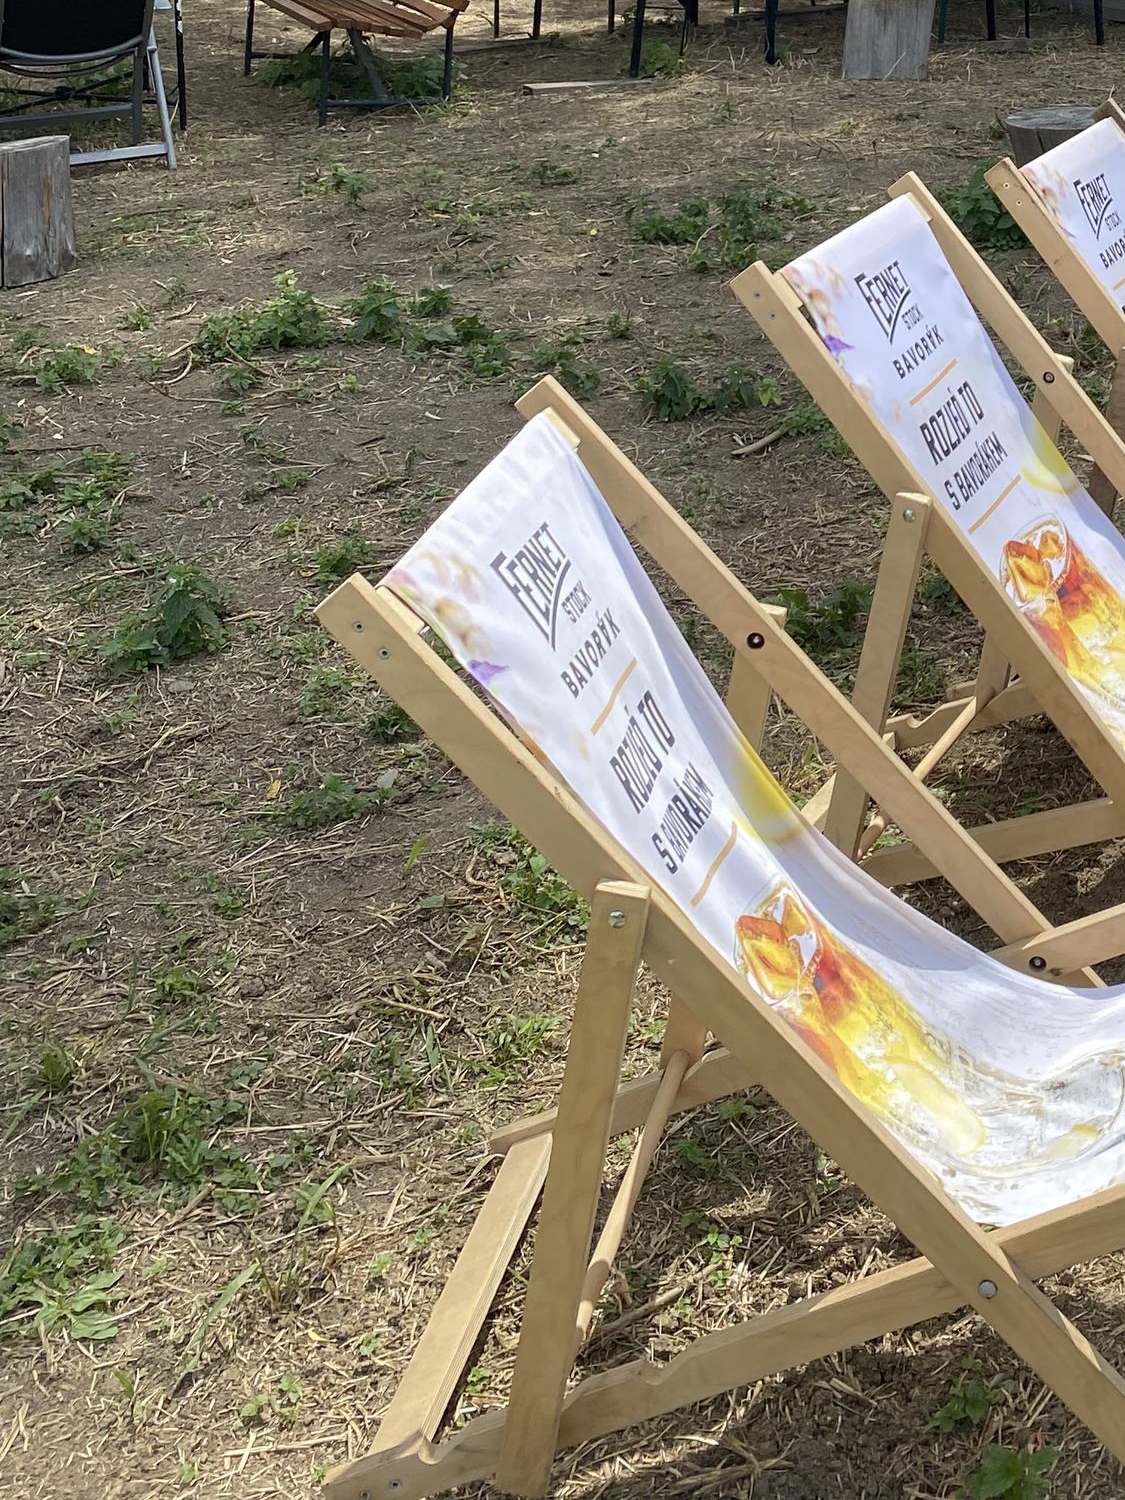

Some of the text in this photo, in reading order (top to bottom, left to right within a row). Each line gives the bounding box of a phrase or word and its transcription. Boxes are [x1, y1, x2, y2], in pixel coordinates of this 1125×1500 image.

[1073, 173, 1112, 234] FERNET
[1104, 211, 1122, 232] STOCK
[854, 260, 911, 340] FERNET
[901, 307, 924, 330] STOCK
[919, 380, 985, 466] ROZJEĎ TO
[944, 431, 1008, 511] S BAVORÁKEM
[490, 522, 570, 646] FERNET
[562, 581, 593, 624] STOCK
[608, 690, 676, 814] ROZJEĎ TO
[651, 832, 679, 875] S
